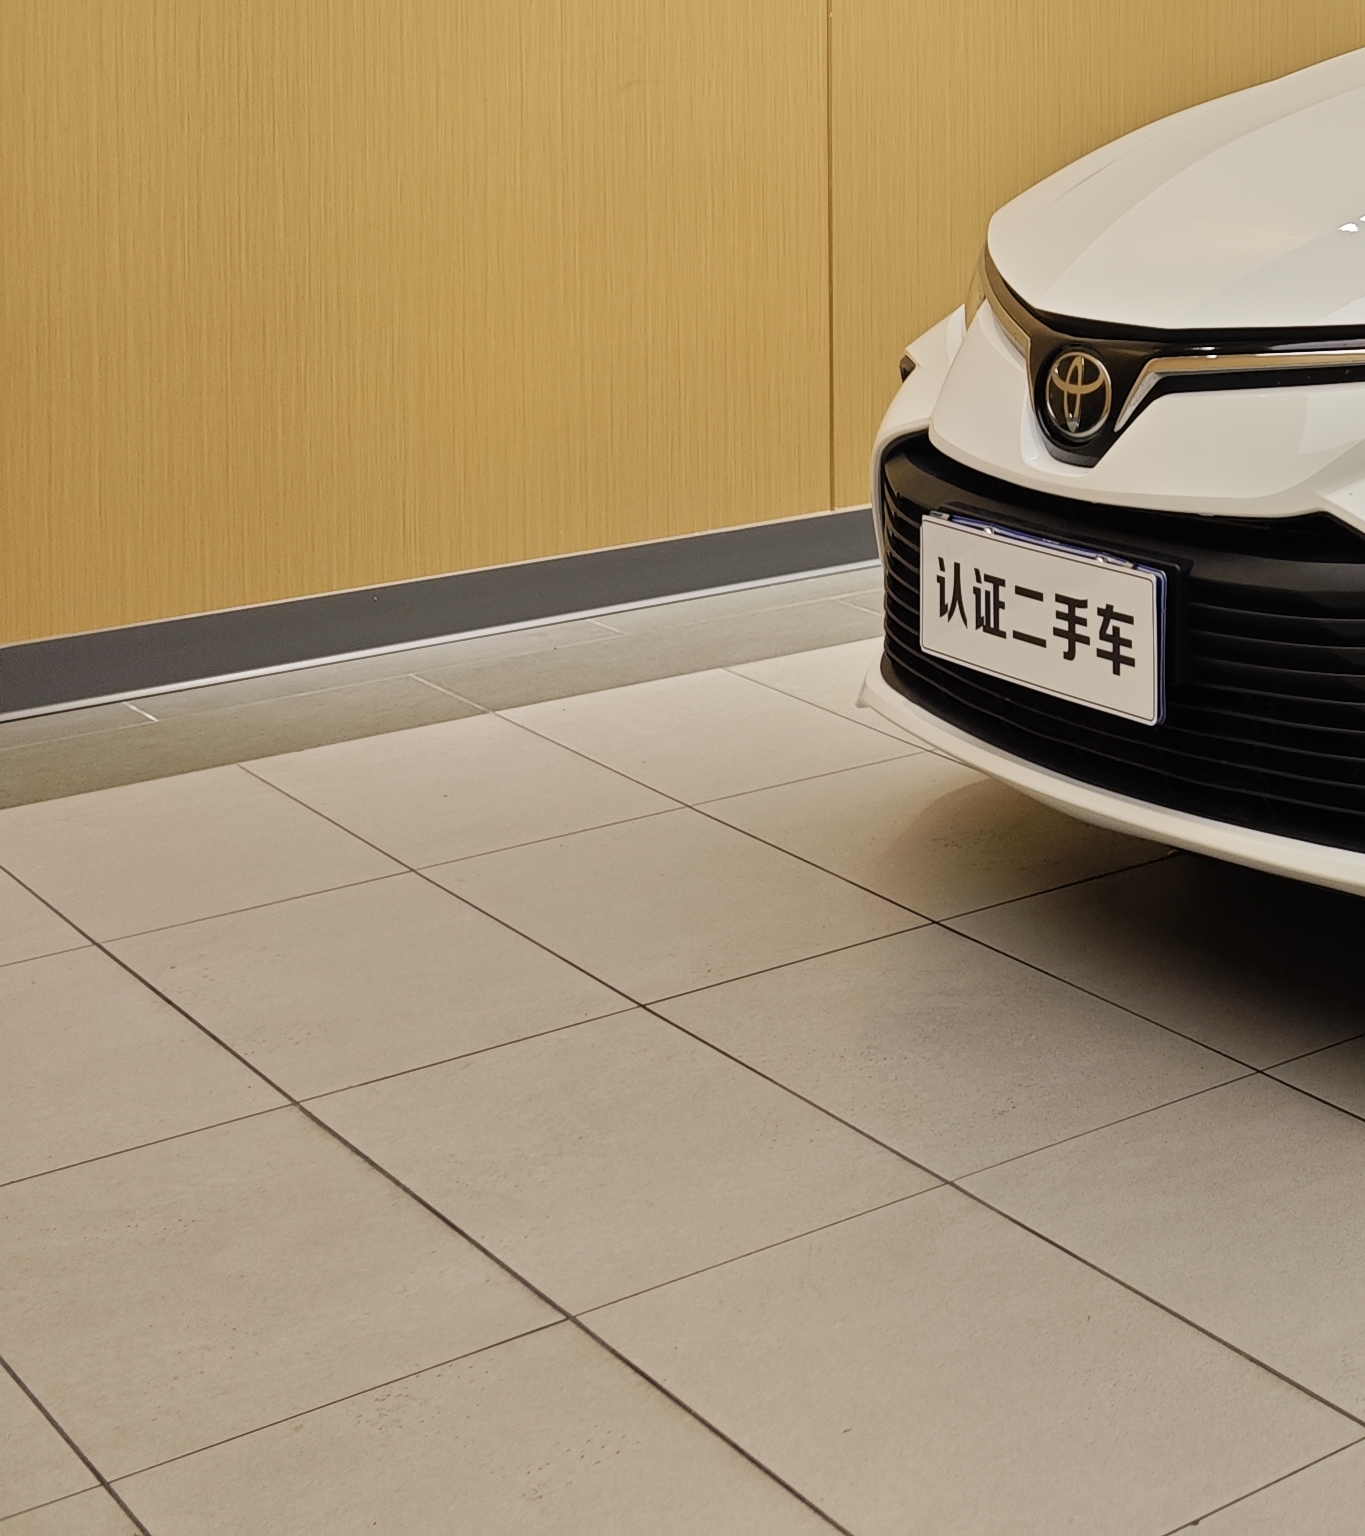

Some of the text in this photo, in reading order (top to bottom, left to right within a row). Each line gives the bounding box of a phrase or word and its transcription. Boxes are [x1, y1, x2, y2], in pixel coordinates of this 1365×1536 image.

[935, 555, 1137, 677] 认证二手车
